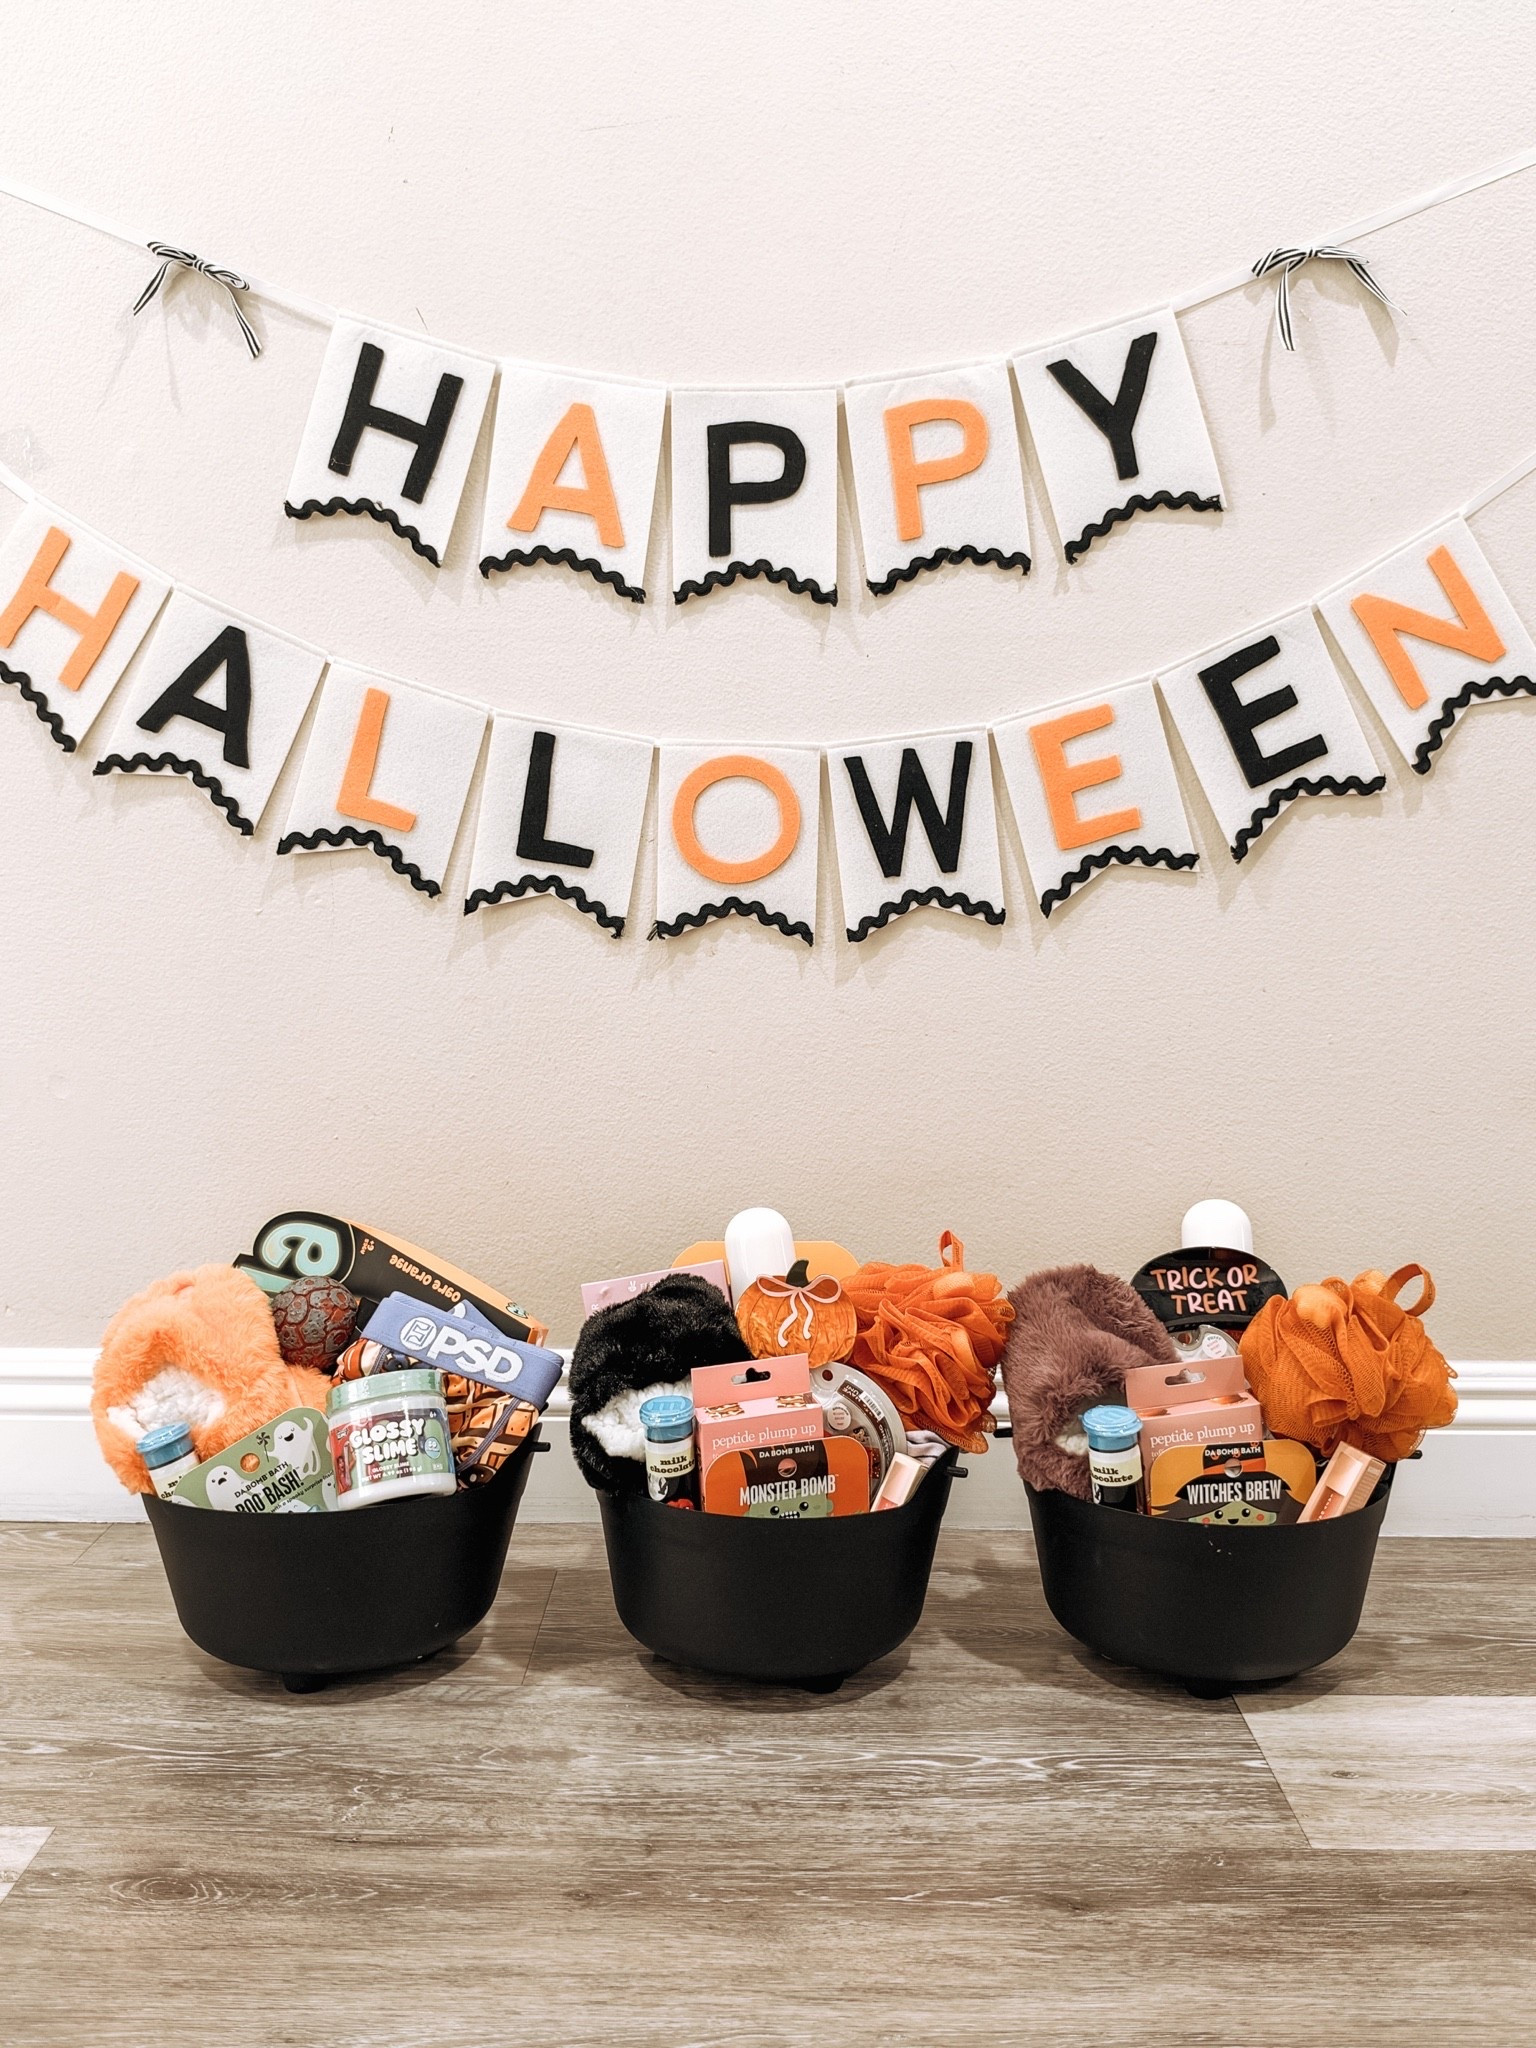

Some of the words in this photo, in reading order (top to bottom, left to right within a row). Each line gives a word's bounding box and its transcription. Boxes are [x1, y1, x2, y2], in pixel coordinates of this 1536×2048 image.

[328, 332, 1158, 558] HAPPY
[0, 526, 1507, 884] HALLOWEEN
[389, 1254, 433, 1286] Orange
[1149, 1266, 1225, 1292] TRICK
[1226, 1263, 1260, 1288] OR
[431, 1279, 461, 1303] Ogre
[1170, 1289, 1248, 1315] TREAT
[426, 1325, 524, 1384] PSD
[349, 1418, 425, 1449] GLOSSY
[711, 1431, 756, 1449] peptide
[758, 1426, 798, 1444] plump
[801, 1423, 817, 1438] up
[1150, 1428, 1194, 1448] peptide
[1197, 1423, 1237, 1440] plump
[1239, 1423, 1256, 1435] up
[361, 1437, 418, 1465] SLIME
[660, 1455, 687, 1466] milk
[758, 1450, 770, 1459] DA
[770, 1448, 794, 1457] BOMB
[795, 1445, 815, 1454] BATH
[1204, 1449, 1216, 1457] DA
[1216, 1447, 1240, 1456] BOMB
[1240, 1446, 1262, 1455] BATH
[234, 1488, 248, 1499] DA
[245, 1474, 269, 1492] BOMB
[267, 1461, 290, 1477] BATH
[1091, 1473, 1133, 1483] ocolate
[1093, 1466, 1119, 1475] milk
[262, 1468, 305, 1506] BASH!
[739, 1479, 798, 1507] MONSTER
[800, 1474, 837, 1499] BOMB
[1186, 1481, 1242, 1505] WITCHES
[1245, 1479, 1282, 1501] BREW
